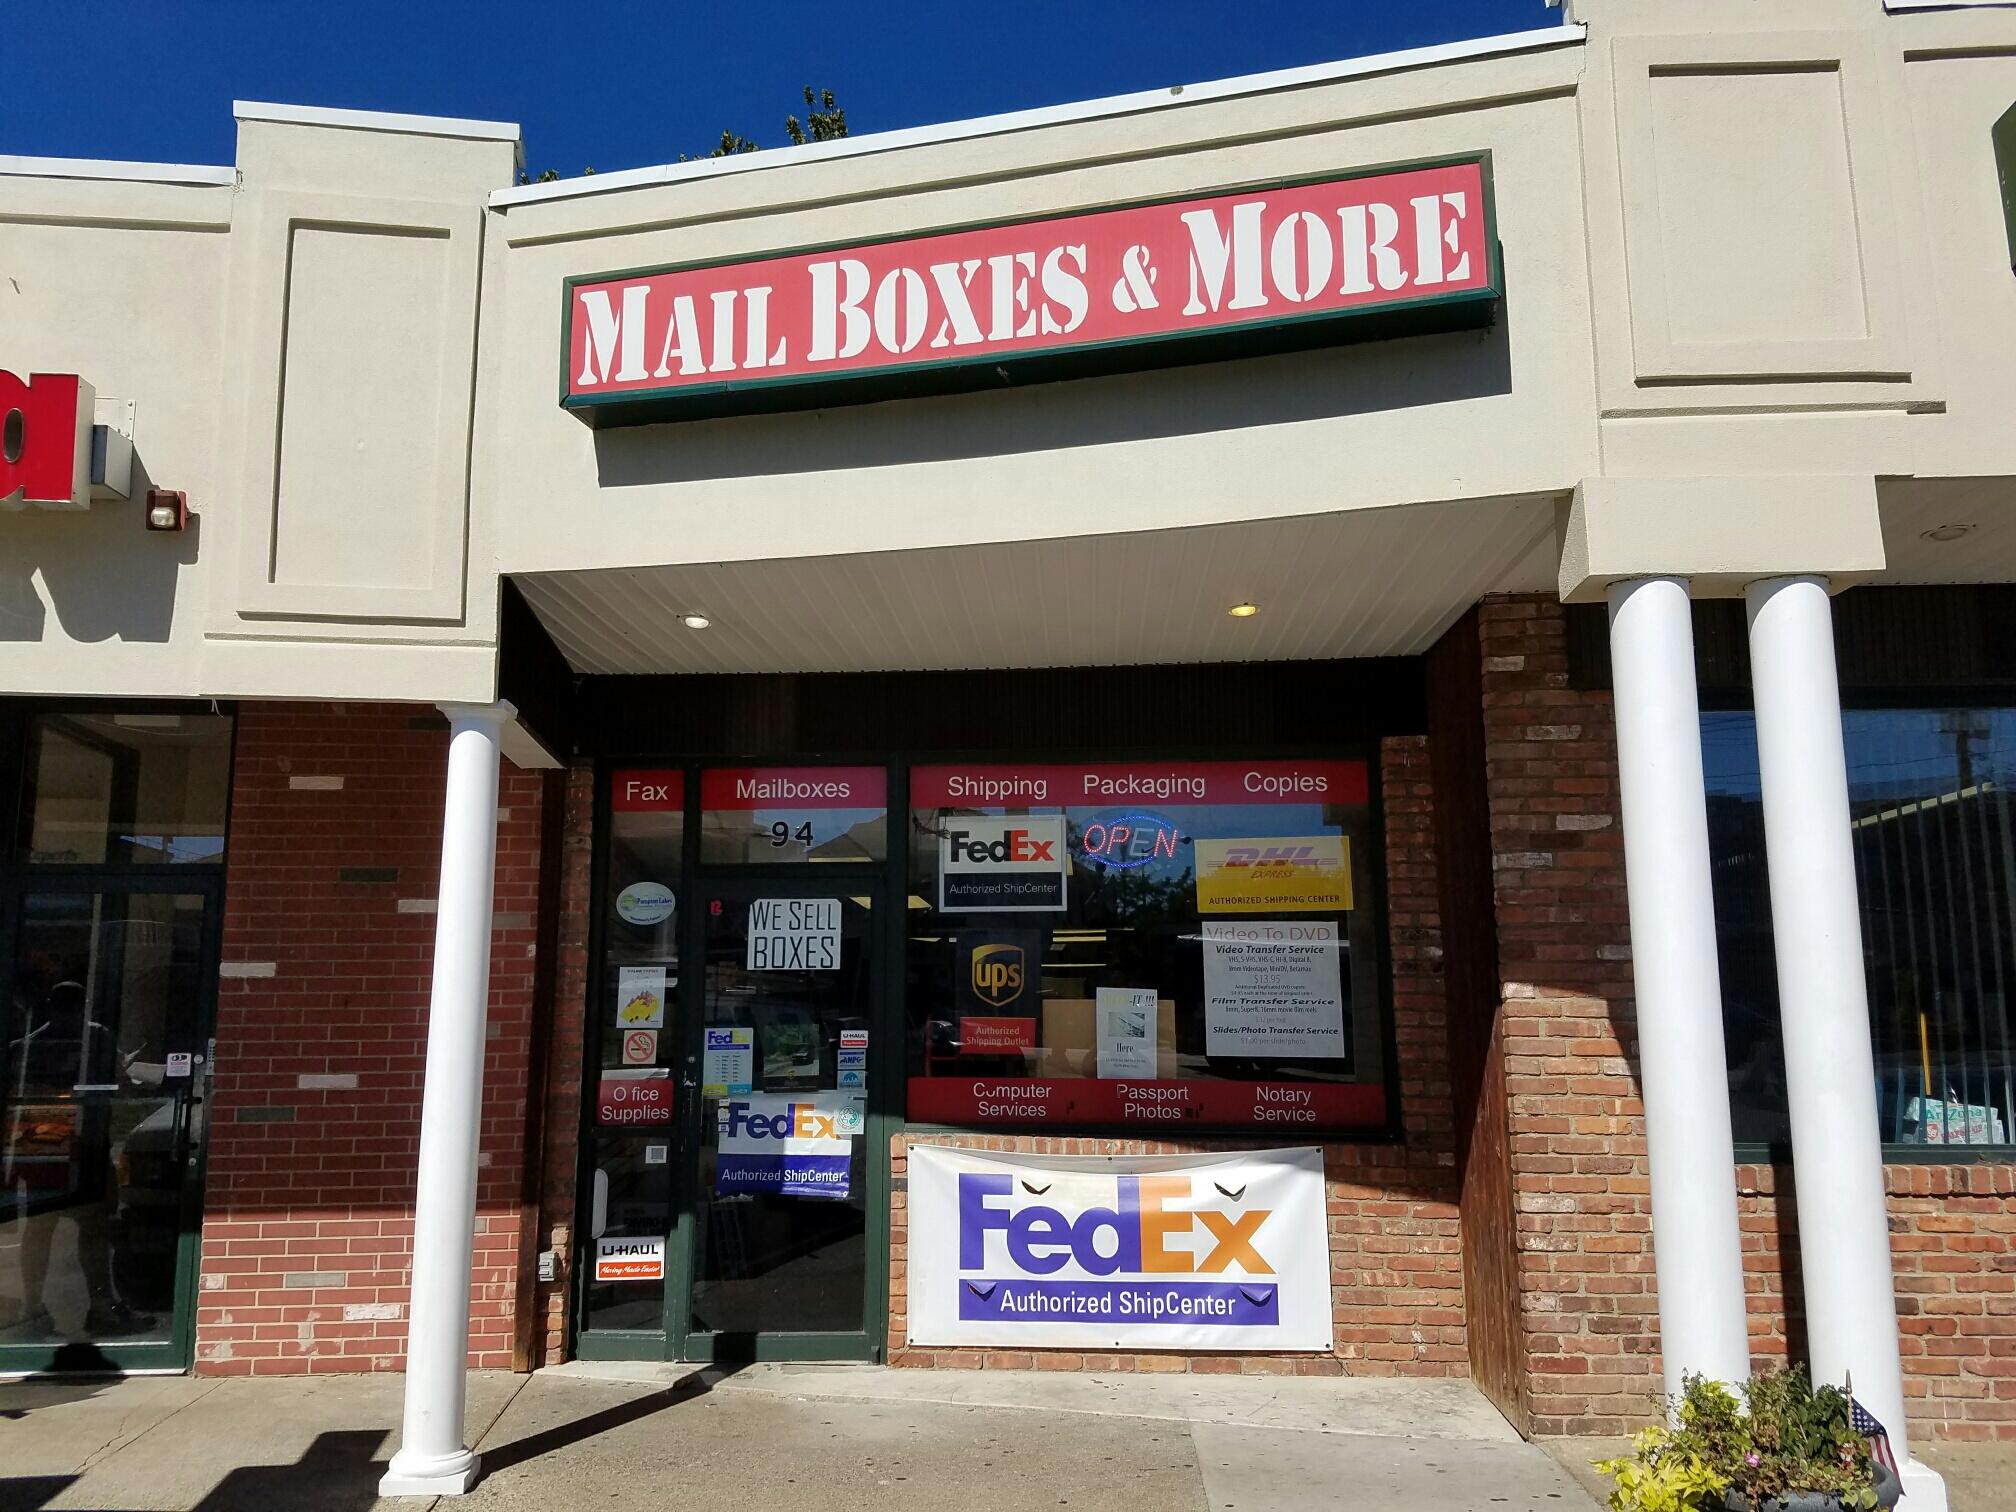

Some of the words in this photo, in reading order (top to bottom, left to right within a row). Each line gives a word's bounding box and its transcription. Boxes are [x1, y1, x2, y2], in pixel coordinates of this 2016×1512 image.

[577, 285, 788, 386] MAIL
[807, 243, 1089, 362] BOXES
[1113, 245, 1159, 313] &
[1181, 191, 1471, 316] MORE
[626, 781, 668, 800] Fax
[736, 779, 850, 799] Mailboxes
[948, 776, 1047, 800] Shipping
[1084, 774, 1205, 798] Packaging
[1244, 772, 1328, 797] Copies
[771, 821, 814, 847] 94
[1084, 824, 1178, 858] OPEN
[951, 829, 1055, 863] FedEx
[1223, 847, 1319, 867] DHL
[1251, 870, 1294, 879] EXPRESS
[950, 884, 1001, 894] Authorized
[1004, 883, 1057, 895] ShipCenter
[1209, 896, 1262, 905] AUTHORIZED
[1264, 896, 1305, 904] SHIPPING
[1307, 895, 1340, 903] CENTER
[752, 901, 781, 931] WE
[789, 901, 836, 930] SELL
[1207, 927, 1258, 941] Video
[1263, 927, 1284, 941] To
[1290, 927, 1331, 941] DVD
[753, 936, 835, 969] BOXES
[1216, 945, 1243, 954] Video
[1246, 945, 1287, 954] Transfer
[1289, 945, 1325, 954] Service
[976, 963, 1021, 997] ups
[1254, 975, 1281, 984] $13.95
[1289, 998, 1335, 1006] Service
[976, 1026, 1020, 1035] Authorized
[1213, 1027, 1267, 1035] Slides/Photo
[1268, 1027, 1304, 1035] Transfer
[1306, 1027, 1339, 1035] Service
[966, 1036, 1002, 1046] Shipping
[1004, 1036, 1029, 1046] Outlet
[1116, 1042, 1135, 1053] Here
[1116, 1084, 1189, 1103] Passport
[1256, 1087, 1311, 1105] Notary
[601, 1105, 669, 1123] Supplies
[978, 1101, 1046, 1118] Services
[1125, 1103, 1181, 1119] Photos
[1254, 1106, 1316, 1122] Service
[727, 1102, 842, 1140] FedEx
[722, 1168, 781, 1182] Authorized
[784, 1168, 844, 1184] ShipCenter
[959, 1173, 1277, 1276] FedEx
[602, 1244, 659, 1256] U-HAUL
[1000, 1289, 1112, 1313] Authorized
[1119, 1292, 1235, 1318] ShipCenter
